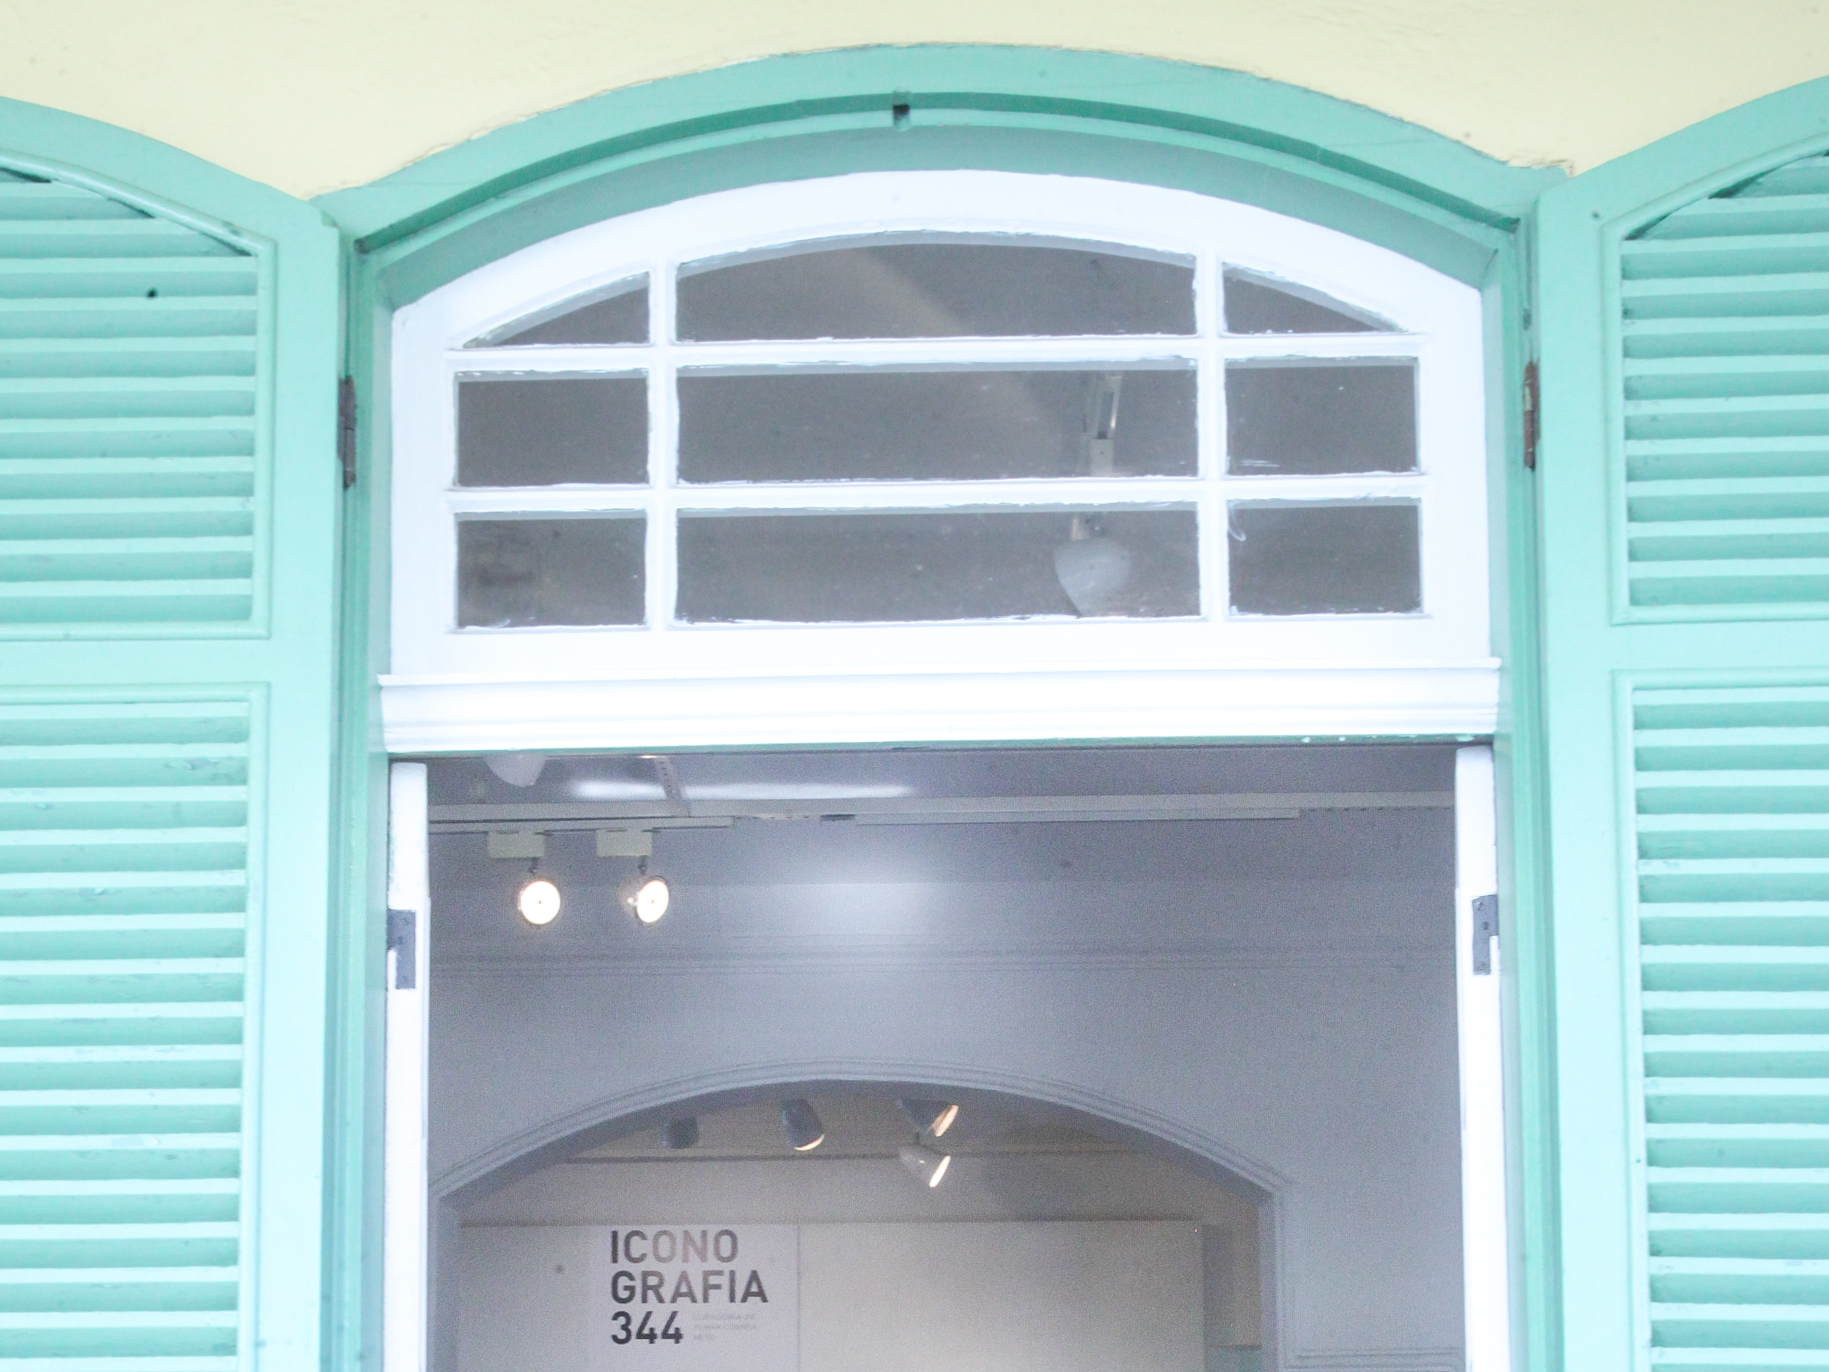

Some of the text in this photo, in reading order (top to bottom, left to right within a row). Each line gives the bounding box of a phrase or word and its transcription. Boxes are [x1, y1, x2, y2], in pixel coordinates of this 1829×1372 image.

[611, 1229, 739, 1264] ICONO
[611, 1269, 769, 1304] GRAFIA
[611, 1310, 684, 1345] 344
